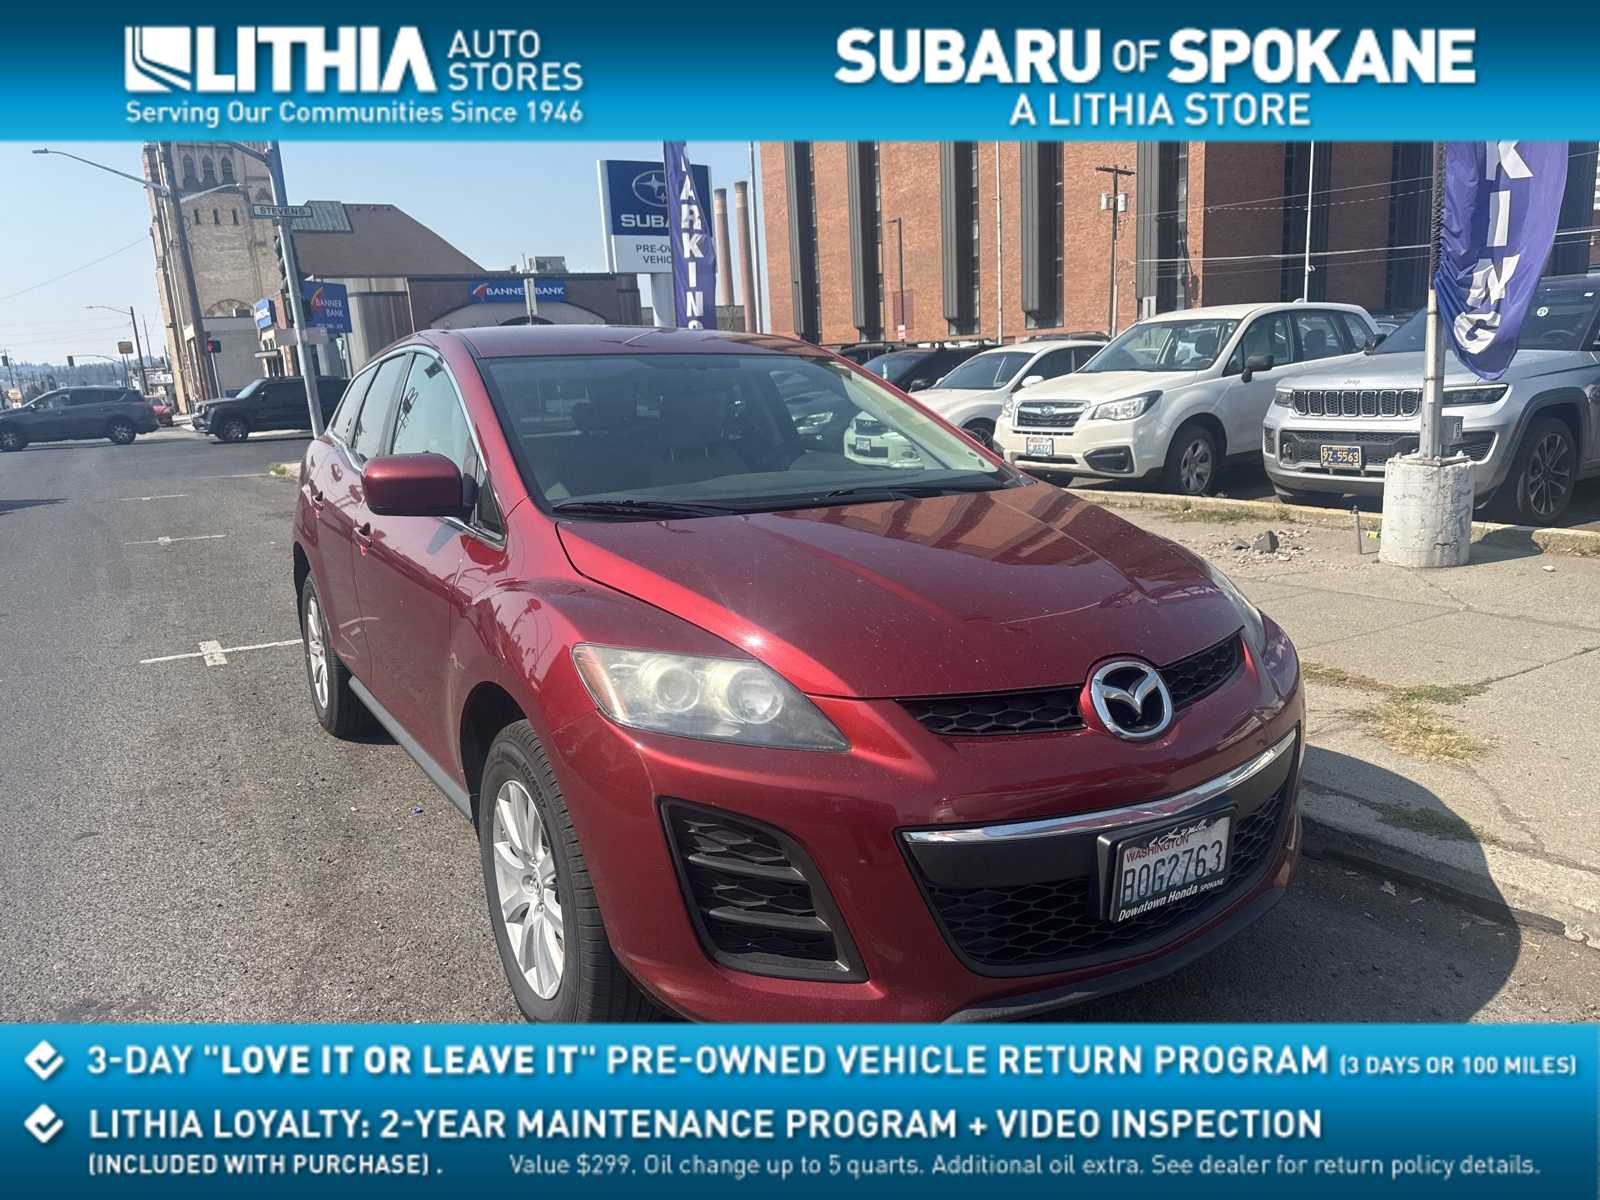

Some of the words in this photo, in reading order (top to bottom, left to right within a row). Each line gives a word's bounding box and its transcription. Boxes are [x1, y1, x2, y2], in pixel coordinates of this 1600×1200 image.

[260, 206, 306, 216] STEVENS
[535, 287, 564, 295] BANK
[315, 298, 343, 307] BANNER
[326, 309, 344, 318] BANK
[1126, 834, 1190, 863] WASHINGTON
[1118, 895, 1167, 922] Downtown
[1168, 884, 1199, 904] Honda
